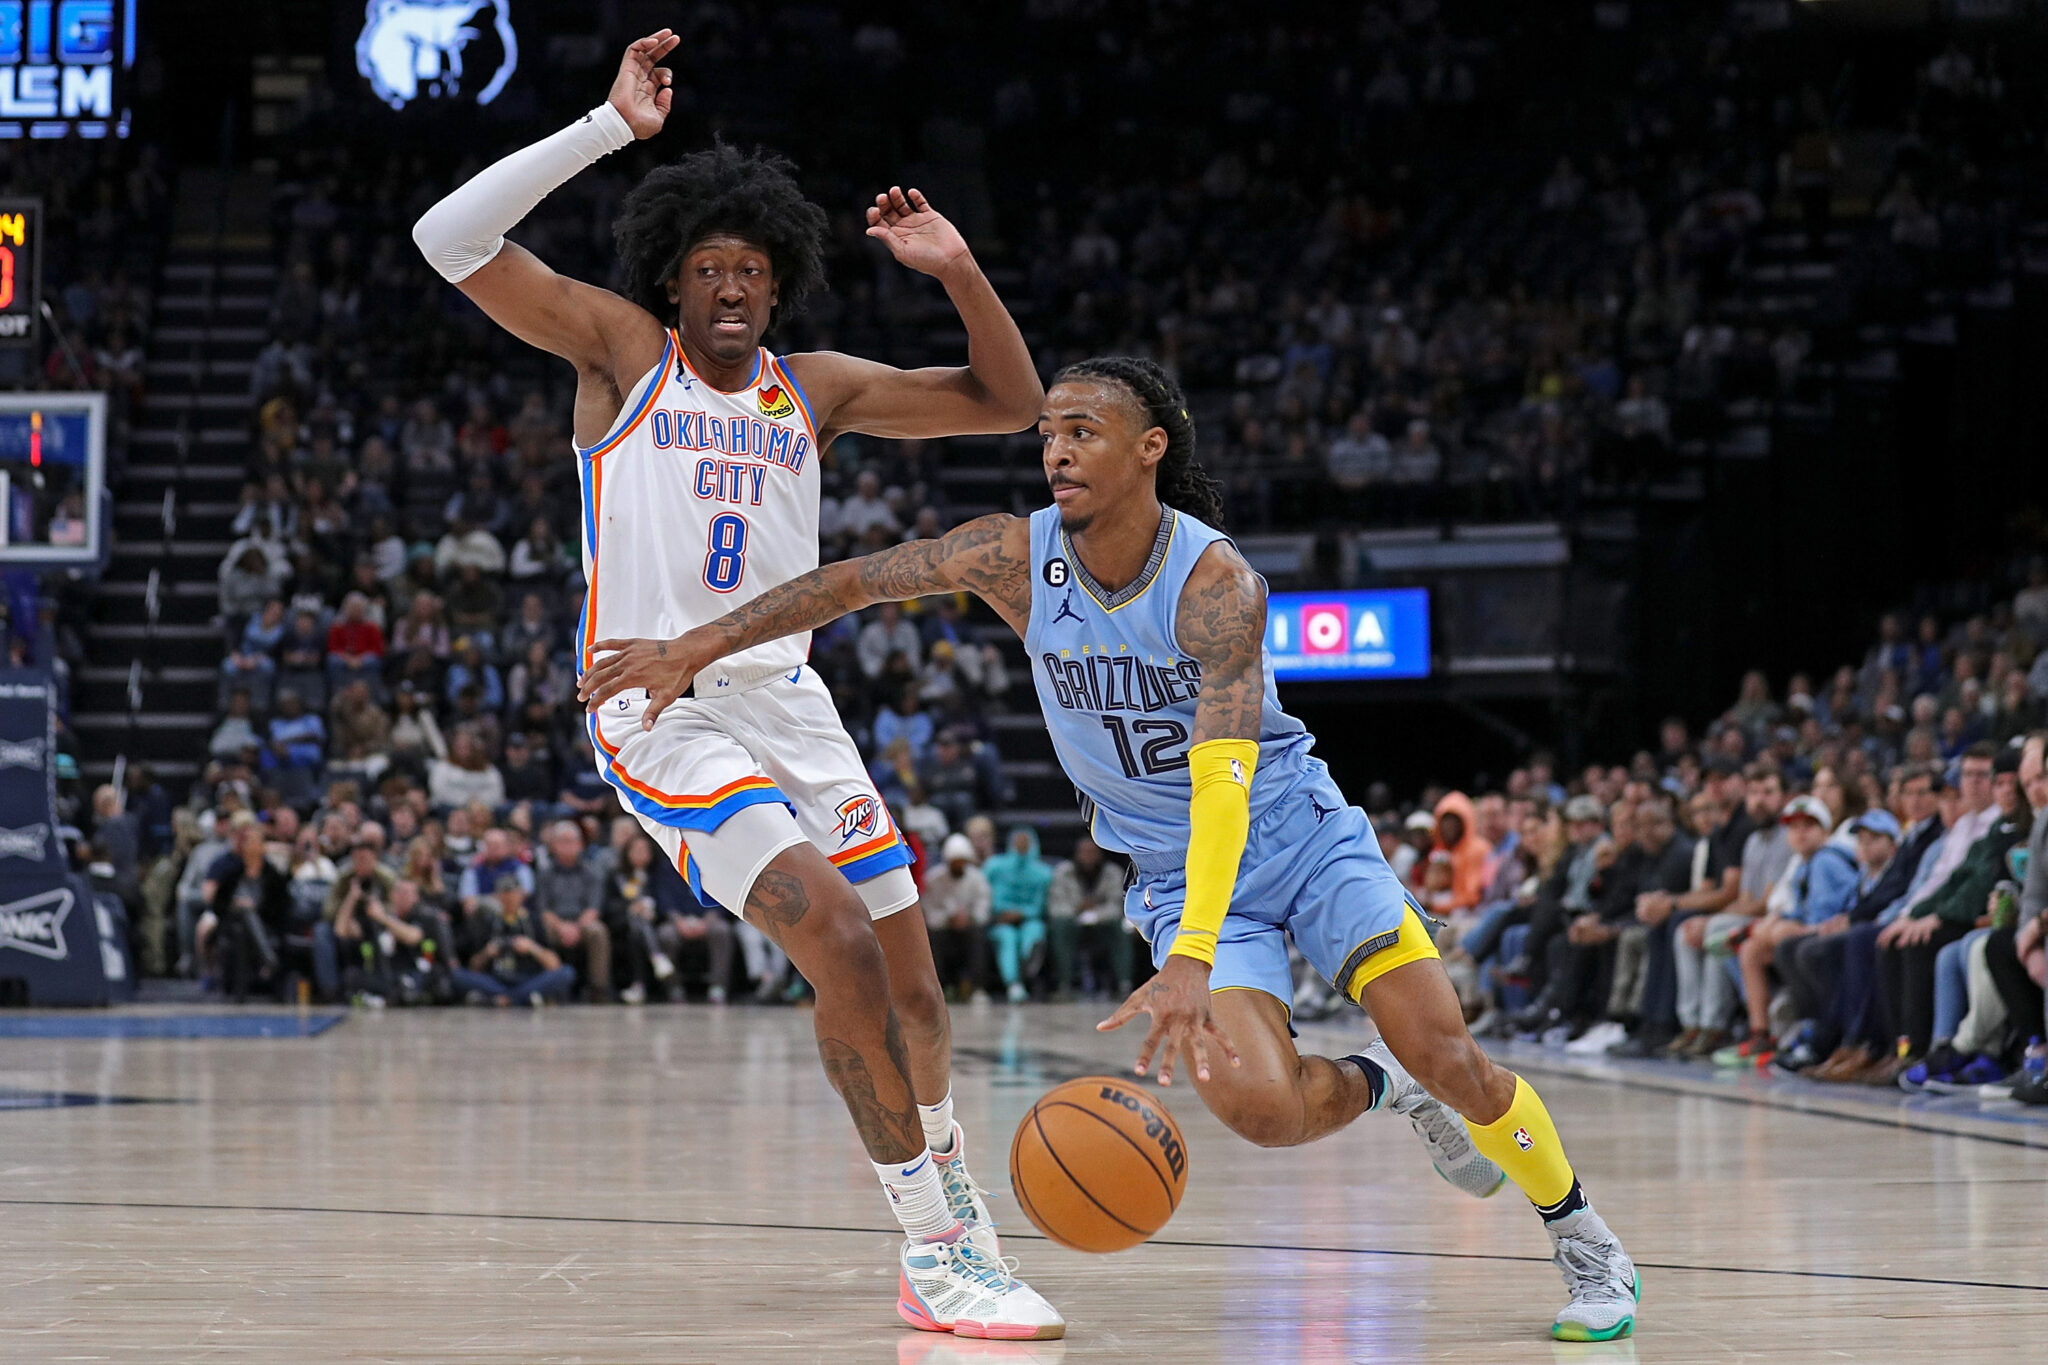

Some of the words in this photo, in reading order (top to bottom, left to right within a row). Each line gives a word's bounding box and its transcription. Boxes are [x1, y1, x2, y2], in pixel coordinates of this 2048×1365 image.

[650, 408, 810, 476] OKLAHOMA
[694, 458, 767, 506] CITY
[702, 511, 749, 594] 8
[1050, 562, 1065, 584] 6
[1043, 653, 1202, 713] GRIZZLIES
[1101, 715, 1190, 779] 12
[843, 800, 872, 838] OKC
